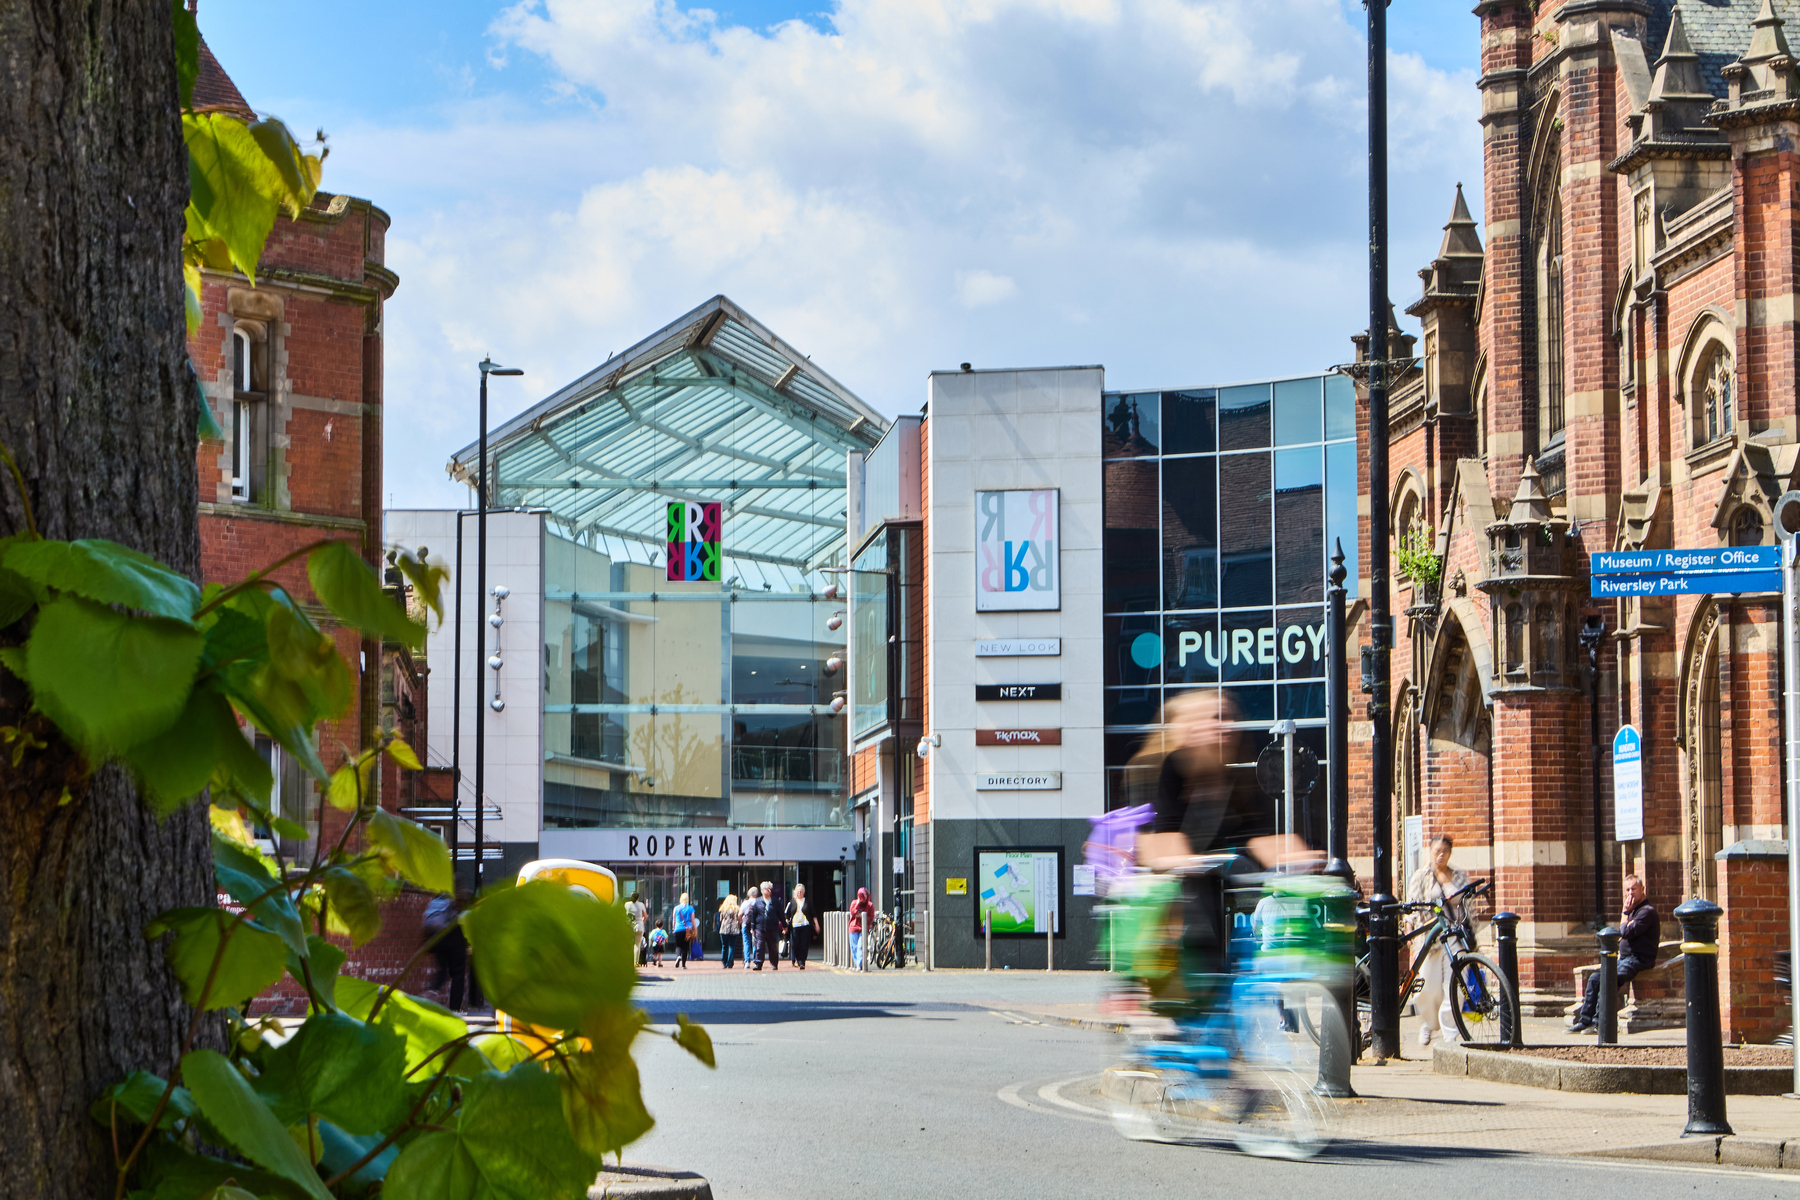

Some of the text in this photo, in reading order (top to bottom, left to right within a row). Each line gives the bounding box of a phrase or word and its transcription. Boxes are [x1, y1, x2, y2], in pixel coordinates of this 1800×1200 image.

[1600, 550, 1760, 569] Museum / Register Office
[1600, 577, 1688, 594] Riversley Park
[980, 643, 1057, 652] NEW LOOK
[999, 687, 1036, 698] NEXT
[988, 777, 1048, 785] DIRECTORY
[628, 835, 765, 856] ROPEWALK
